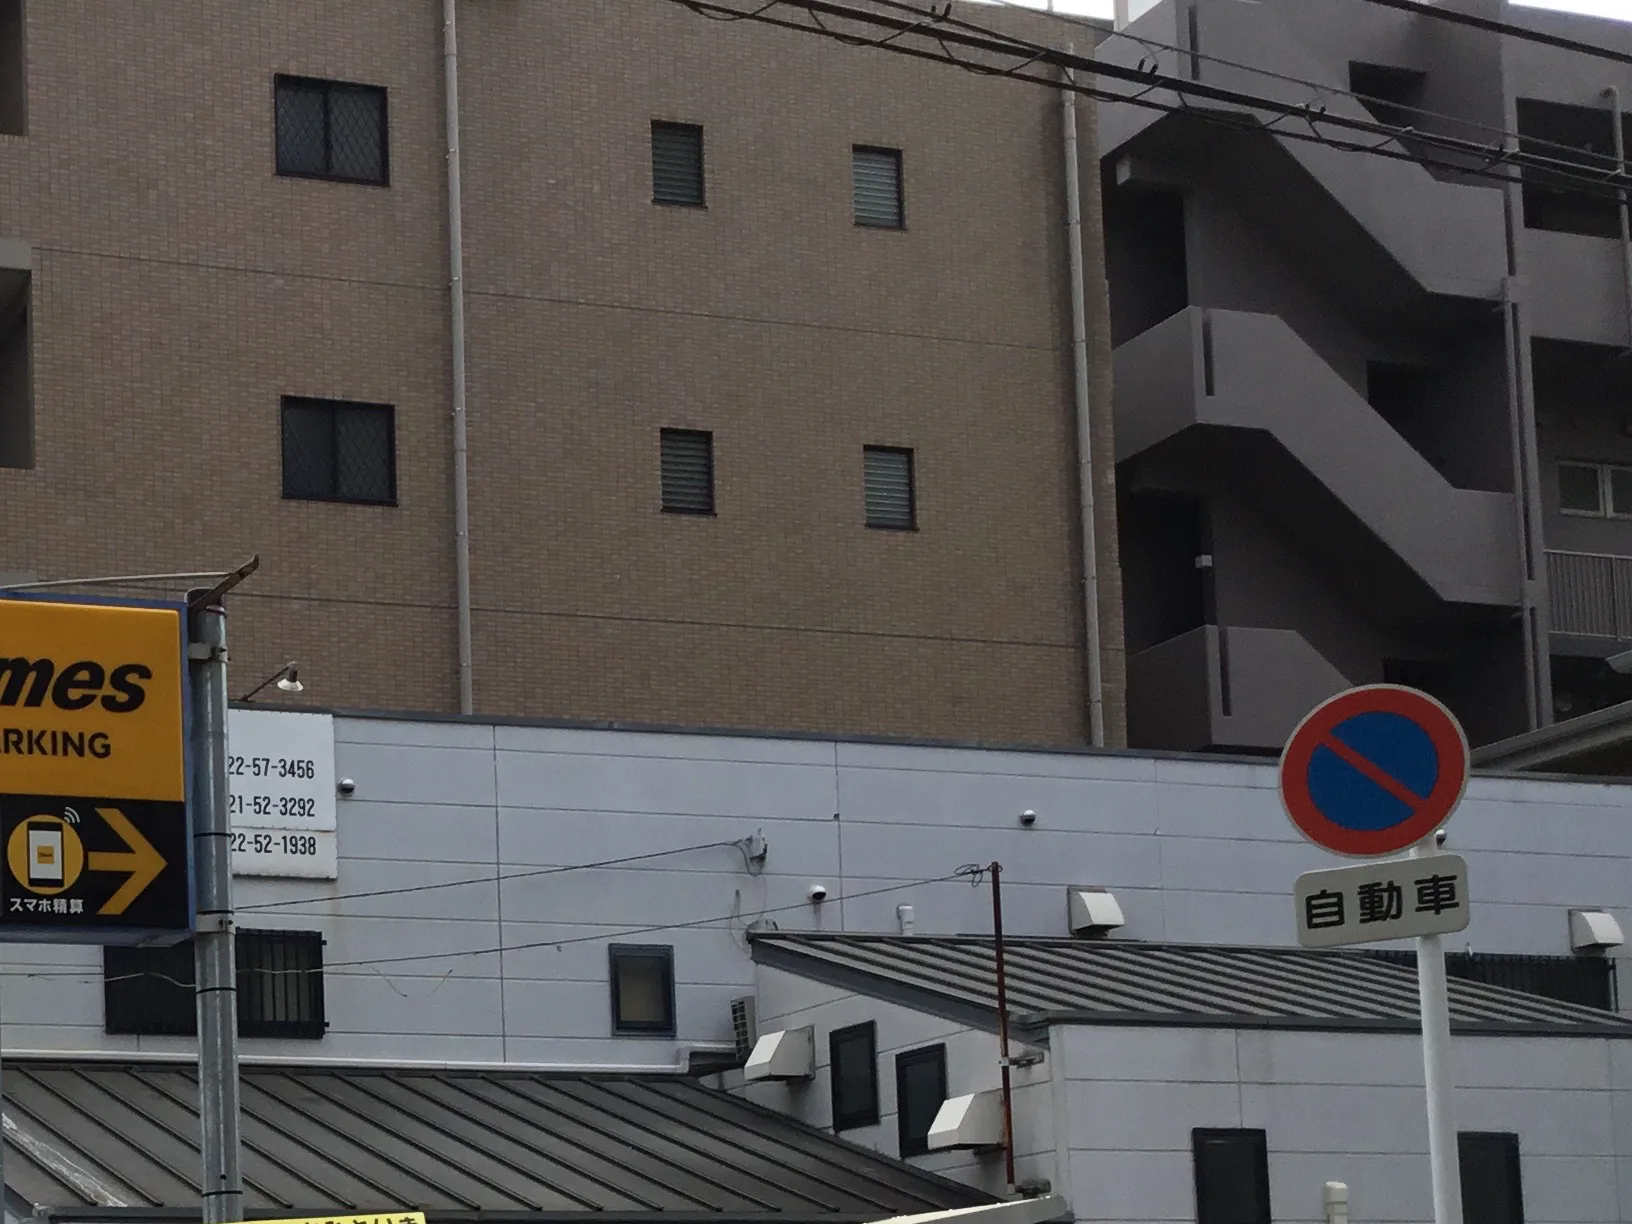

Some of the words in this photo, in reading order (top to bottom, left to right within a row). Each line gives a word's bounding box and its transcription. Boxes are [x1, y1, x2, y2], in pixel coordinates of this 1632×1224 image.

[10, 898, 83, 914] スマホ精算
[1305, 874, 1460, 929] 自動車
